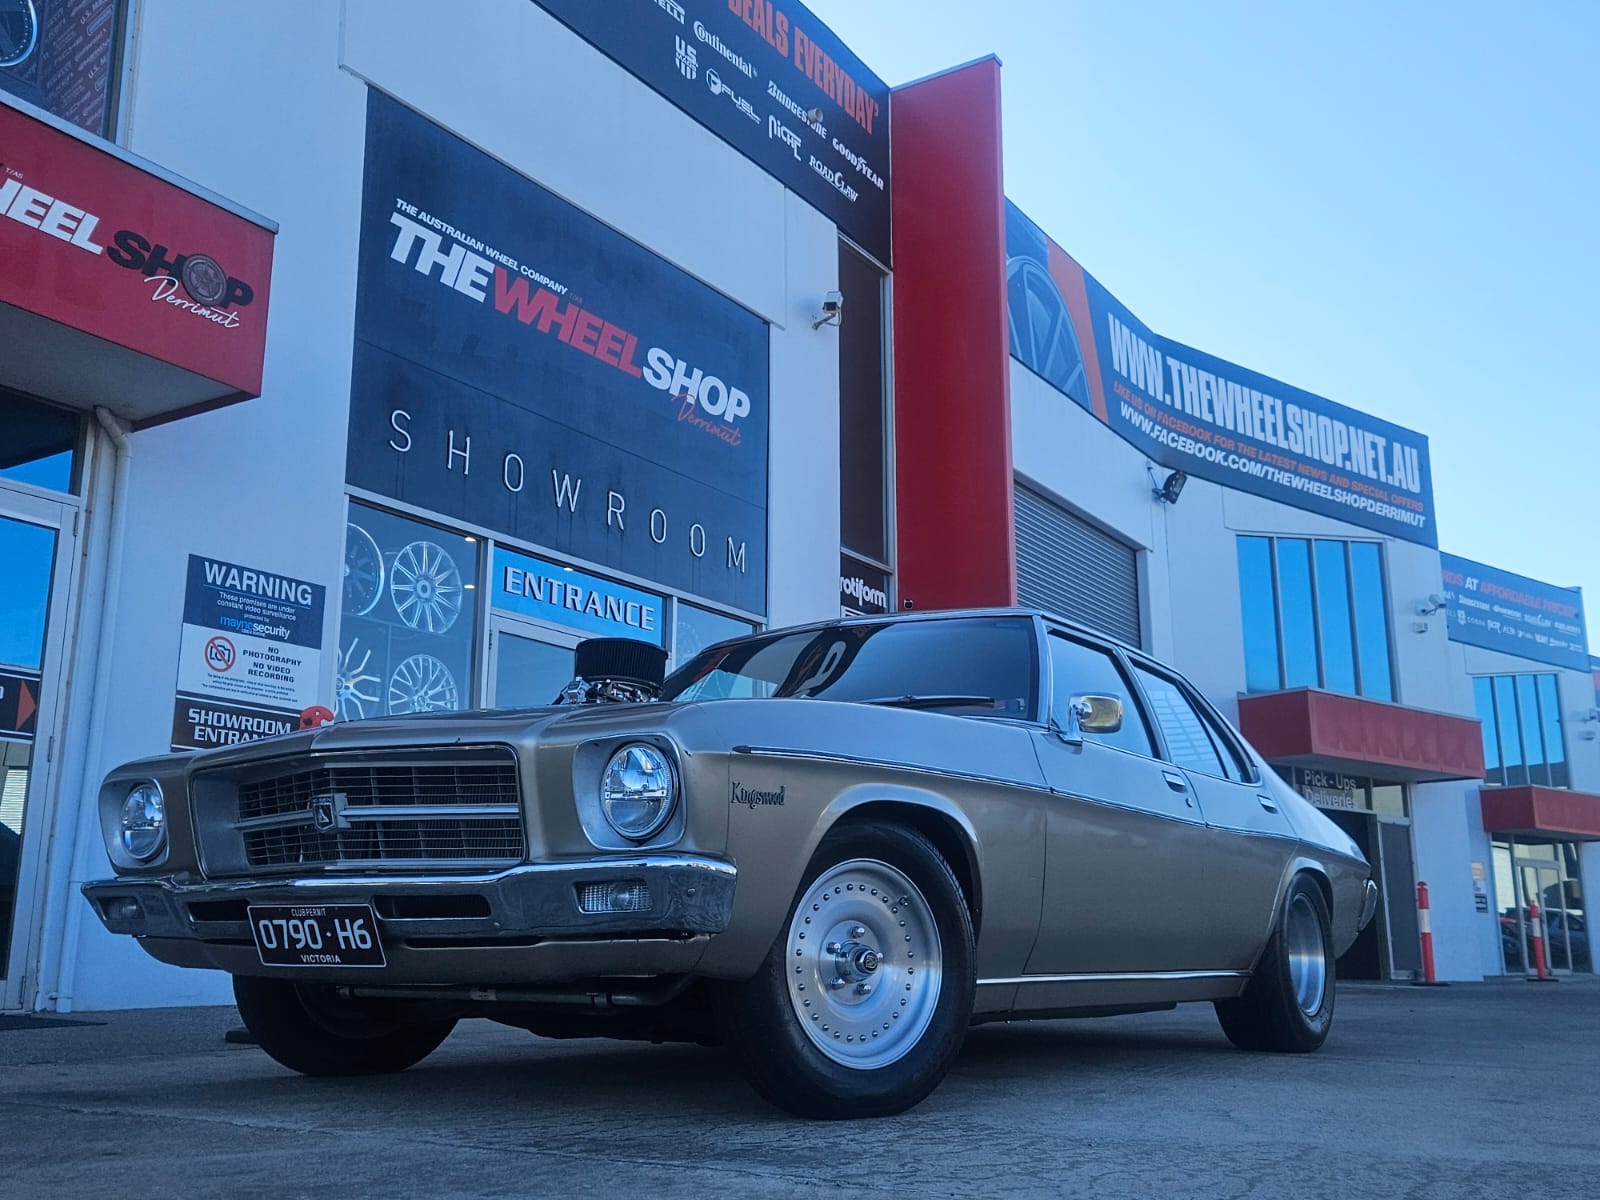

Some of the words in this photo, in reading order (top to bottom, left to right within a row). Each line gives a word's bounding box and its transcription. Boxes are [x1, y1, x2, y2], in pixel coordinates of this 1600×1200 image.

[728, 0, 789, 58] EALS
[693, 20, 752, 79] Continental
[721, 83, 761, 122] FUEL
[6, 167, 23, 179] T/AS
[832, 138, 884, 190] GOODYEAR
[396, 198, 418, 217] THE
[418, 211, 485, 252] AUSTRALIAN
[485, 245, 519, 271] WHEEL
[521, 265, 568, 295] COMPANY
[144, 276, 239, 328] Derrimut
[670, 394, 742, 447] Derrimut
[1108, 312, 1421, 494] WWW.THEWHEELSHOP.NET.AU
[1113, 381, 1132, 401] LIKE
[1132, 394, 1143, 411] US
[1144, 403, 1156, 418] ON
[1157, 411, 1212, 442] FACEBOOK
[1214, 434, 1234, 450] FOR
[1238, 442, 1257, 458] THE
[1258, 450, 1297, 470] LATEST
[1299, 463, 1328, 482] NEWS
[1329, 473, 1349, 488] AND
[1351, 480, 1389, 501] SPECIAL
[1120, 401, 1426, 528] WWW.FACEBOOK.COM/THEWHEELSHOPDERRIMUT
[389, 409, 746, 574] SHOWROOM
[204, 561, 312, 606] WARNING
[220, 591, 238, 602] These
[278, 604, 296, 614] under
[503, 564, 655, 632] ENTRANCE
[1465, 576, 1479, 591] AT
[217, 599, 244, 610] constant
[244, 605, 261, 614] video
[262, 609, 297, 621] surveillance
[242, 649, 302, 667] PHOTOGRAPHY
[253, 661, 264, 669] NO
[267, 664, 291, 675] VIDEO
[268, 646, 279, 655] NO
[248, 668, 294, 683] RECORDING
[188, 708, 292, 735] SHOWROOM
[194, 725, 266, 744] ENTRA
[1304, 770, 1328, 787] Pick
[300, 954, 342, 963] VICTORIA
